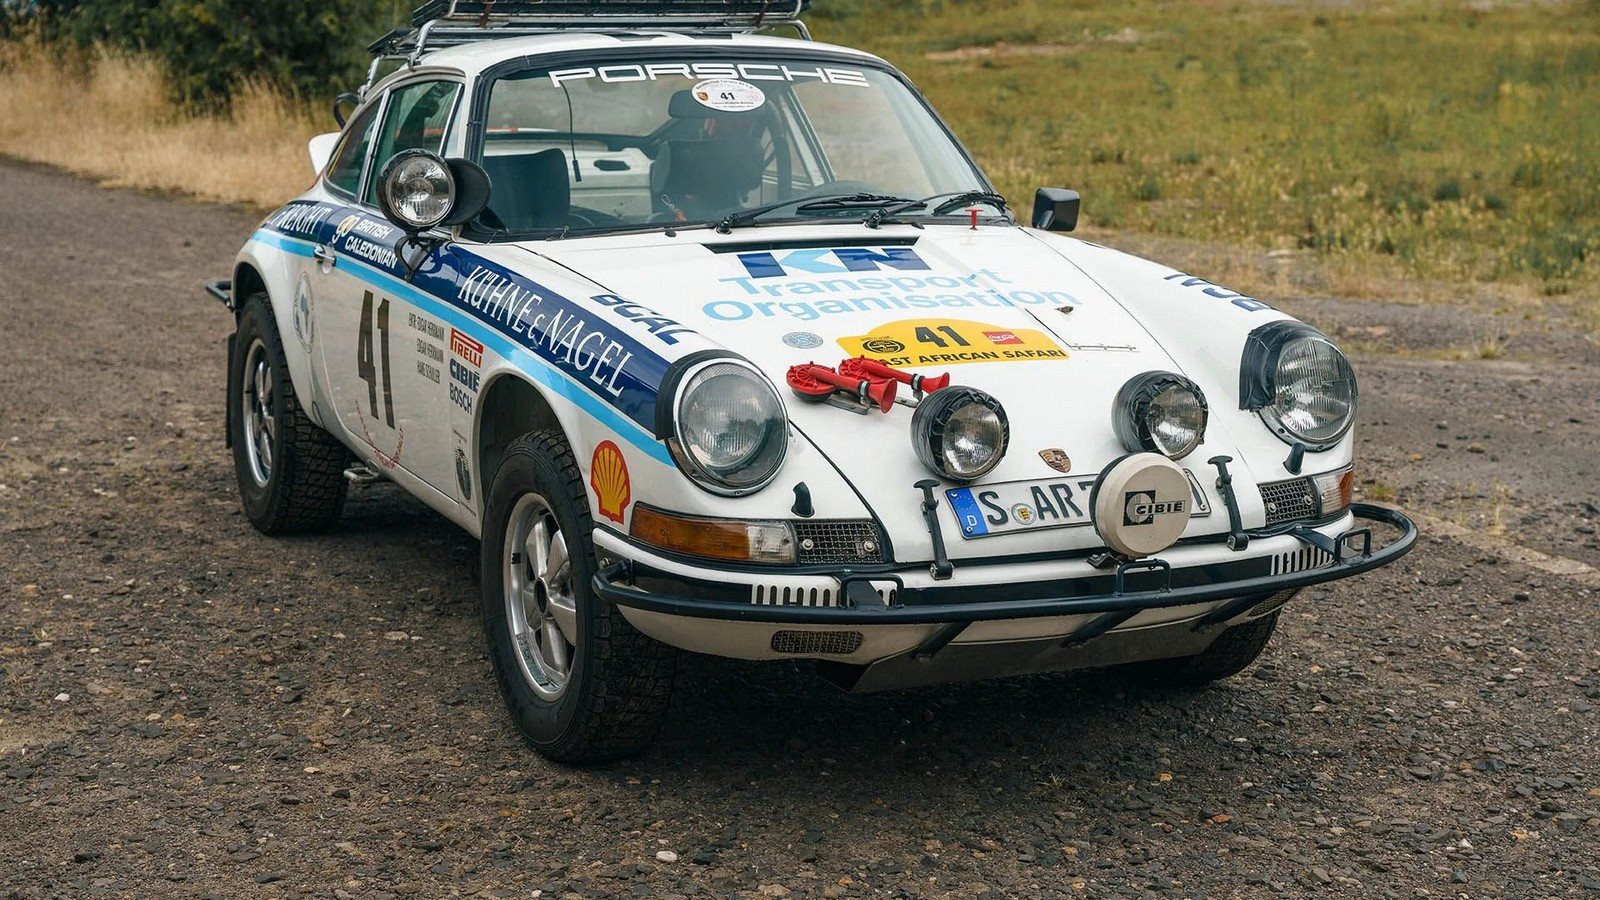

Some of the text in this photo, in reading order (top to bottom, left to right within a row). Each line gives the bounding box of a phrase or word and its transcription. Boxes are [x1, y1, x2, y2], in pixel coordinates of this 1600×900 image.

[548, 62, 870, 88] PORSCHE
[720, 92, 735, 100] 41
[354, 218, 394, 240] BRITISH
[344, 235, 399, 270] CALEDONIAN
[718, 267, 1013, 298] Transport
[702, 287, 1083, 322] Organisation
[449, 327, 484, 369] PIRELLI
[457, 264, 543, 335] KÜHNE
[538, 308, 634, 398] NAGEL
[914, 325, 972, 348] 41
[357, 289, 396, 430] 41
[919, 350, 1000, 366] AFRICAN
[1001, 348, 1067, 360] SAFARI
[449, 381, 473, 416] BOSCH
[966, 515, 978, 528] D
[978, 490, 1009, 526] S
